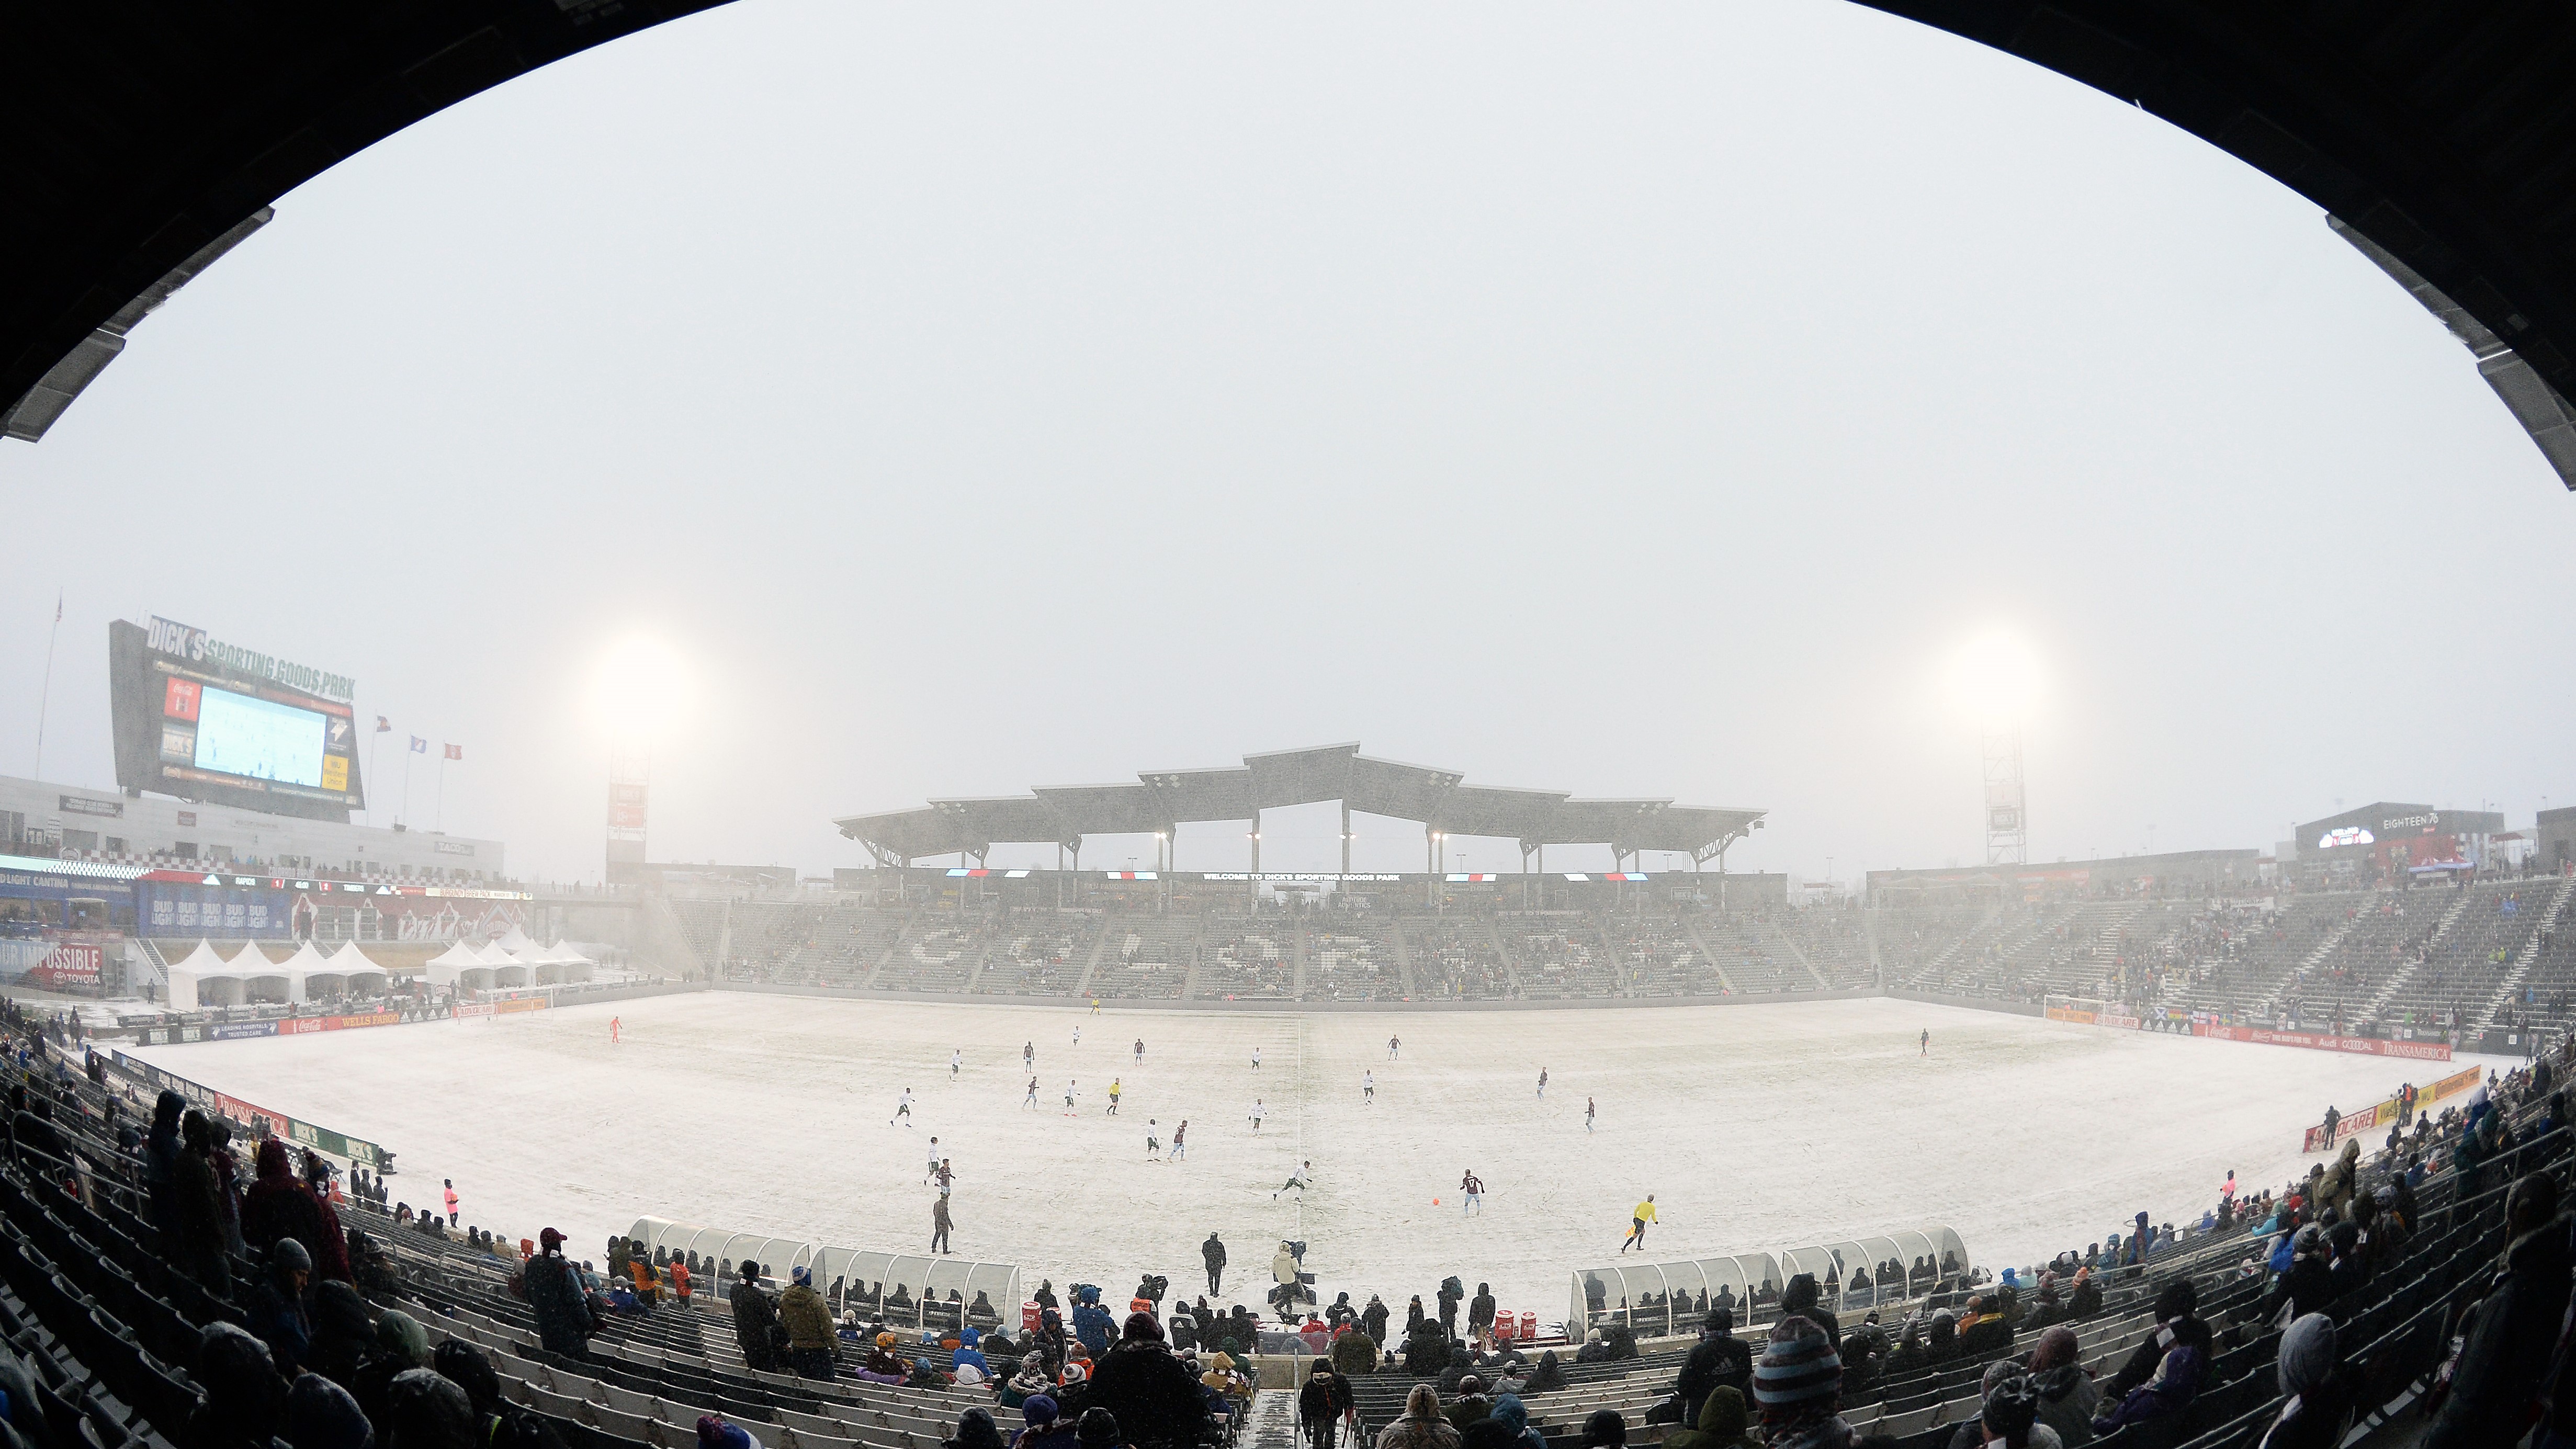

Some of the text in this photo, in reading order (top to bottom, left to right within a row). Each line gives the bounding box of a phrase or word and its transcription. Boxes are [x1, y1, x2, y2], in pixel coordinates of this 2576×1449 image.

[148, 618, 206, 661] DICK'S
[207, 639, 275, 678] SPORTING
[276, 659, 321, 691] GOODS
[322, 672, 355, 700] PARK
[2383, 816, 2427, 830] EIGHTEEN
[2428, 812, 2439, 824] 76
[235, 877, 256, 886] RAPIDS
[344, 884, 364, 892] TIMBERS
[466, 889, 479, 898] BREW
[154, 900, 173, 913] BUD
[178, 902, 197, 914] BUD
[202, 903, 221, 915] BUD
[226, 904, 244, 916] BUD
[249, 905, 268, 916] BUD
[22, 945, 99, 971] IMPOSSIBLE
[67, 973, 100, 984] TOYOTA
[342, 1014, 400, 1027] WELLS FARGO
[2319, 1038, 2337, 1047] Audi
[2382, 1041, 2448, 1060] TRANSAMERICA
[294, 1121, 318, 1143] DICK'S
[345, 1138, 374, 1160] DICK'S
[1468, 1179, 1475, 1187] 17
